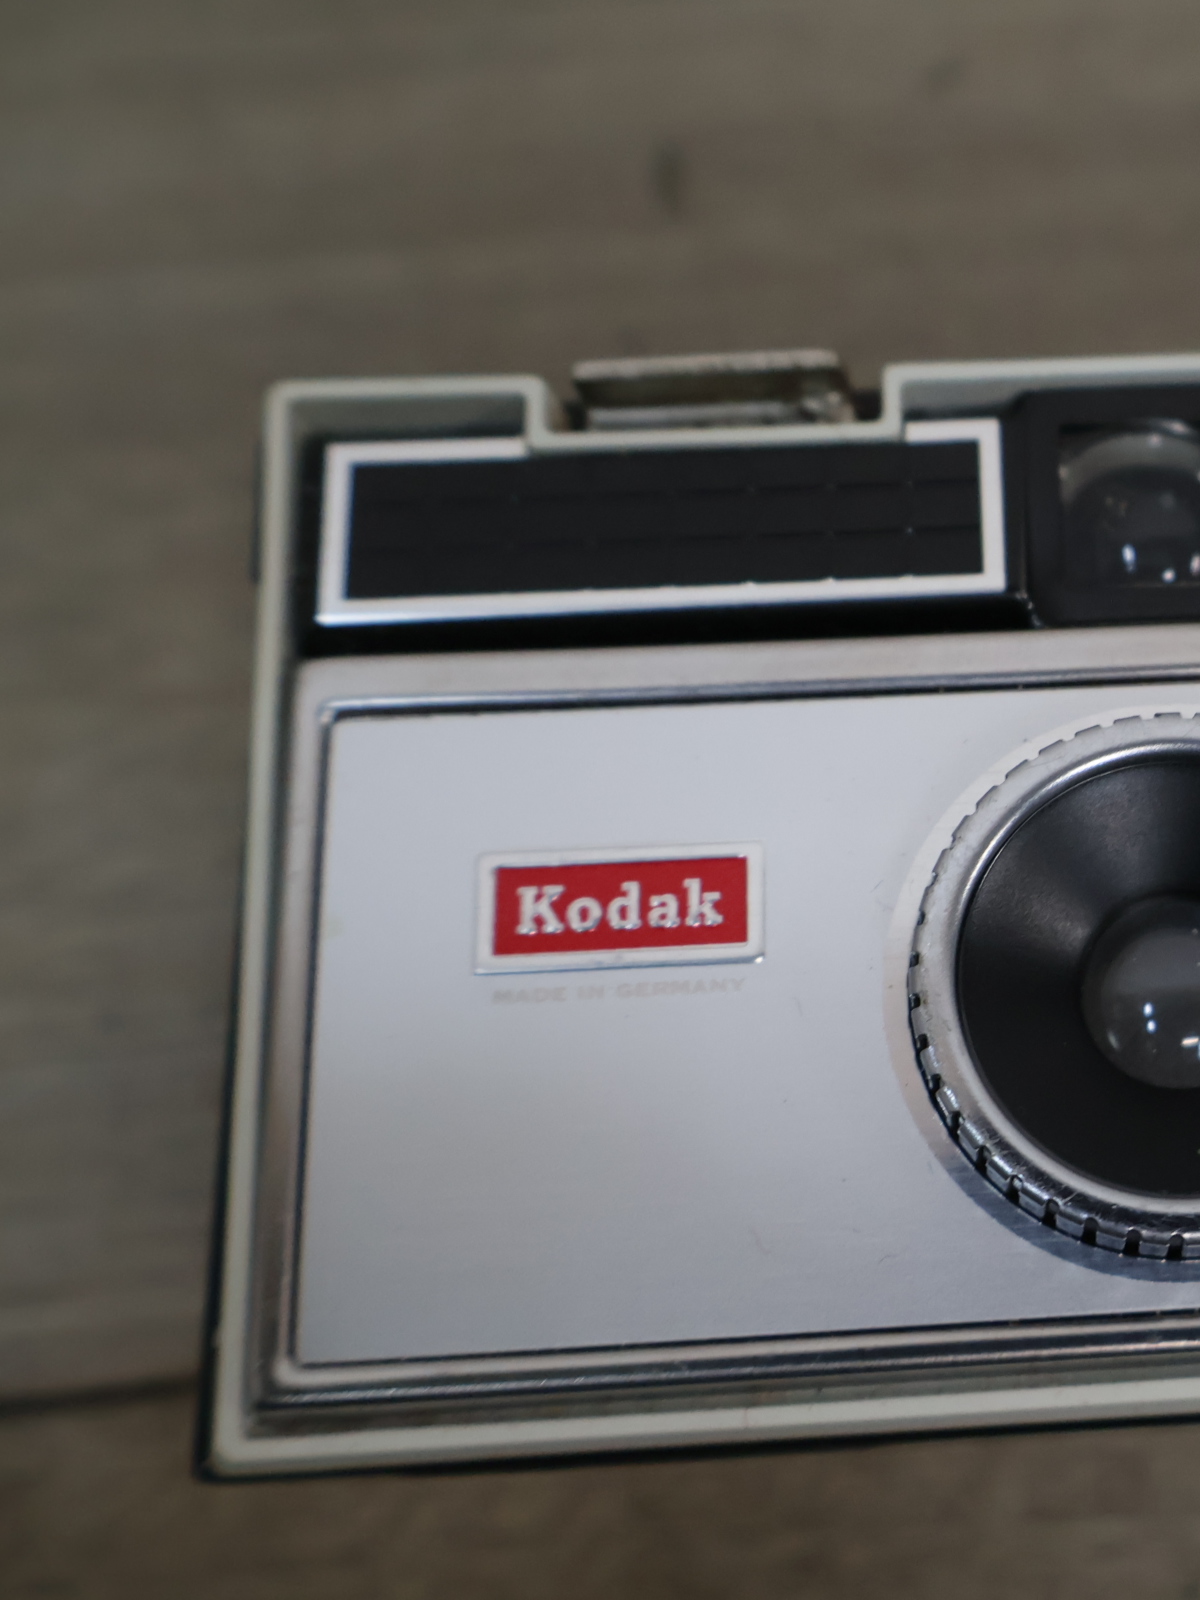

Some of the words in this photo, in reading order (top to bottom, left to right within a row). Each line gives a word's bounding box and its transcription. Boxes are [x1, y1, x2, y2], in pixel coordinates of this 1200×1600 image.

[515, 878, 724, 935] Kodak
[493, 986, 567, 1005] MADE
[578, 984, 605, 1000] IN
[616, 977, 746, 999] GERMANY
